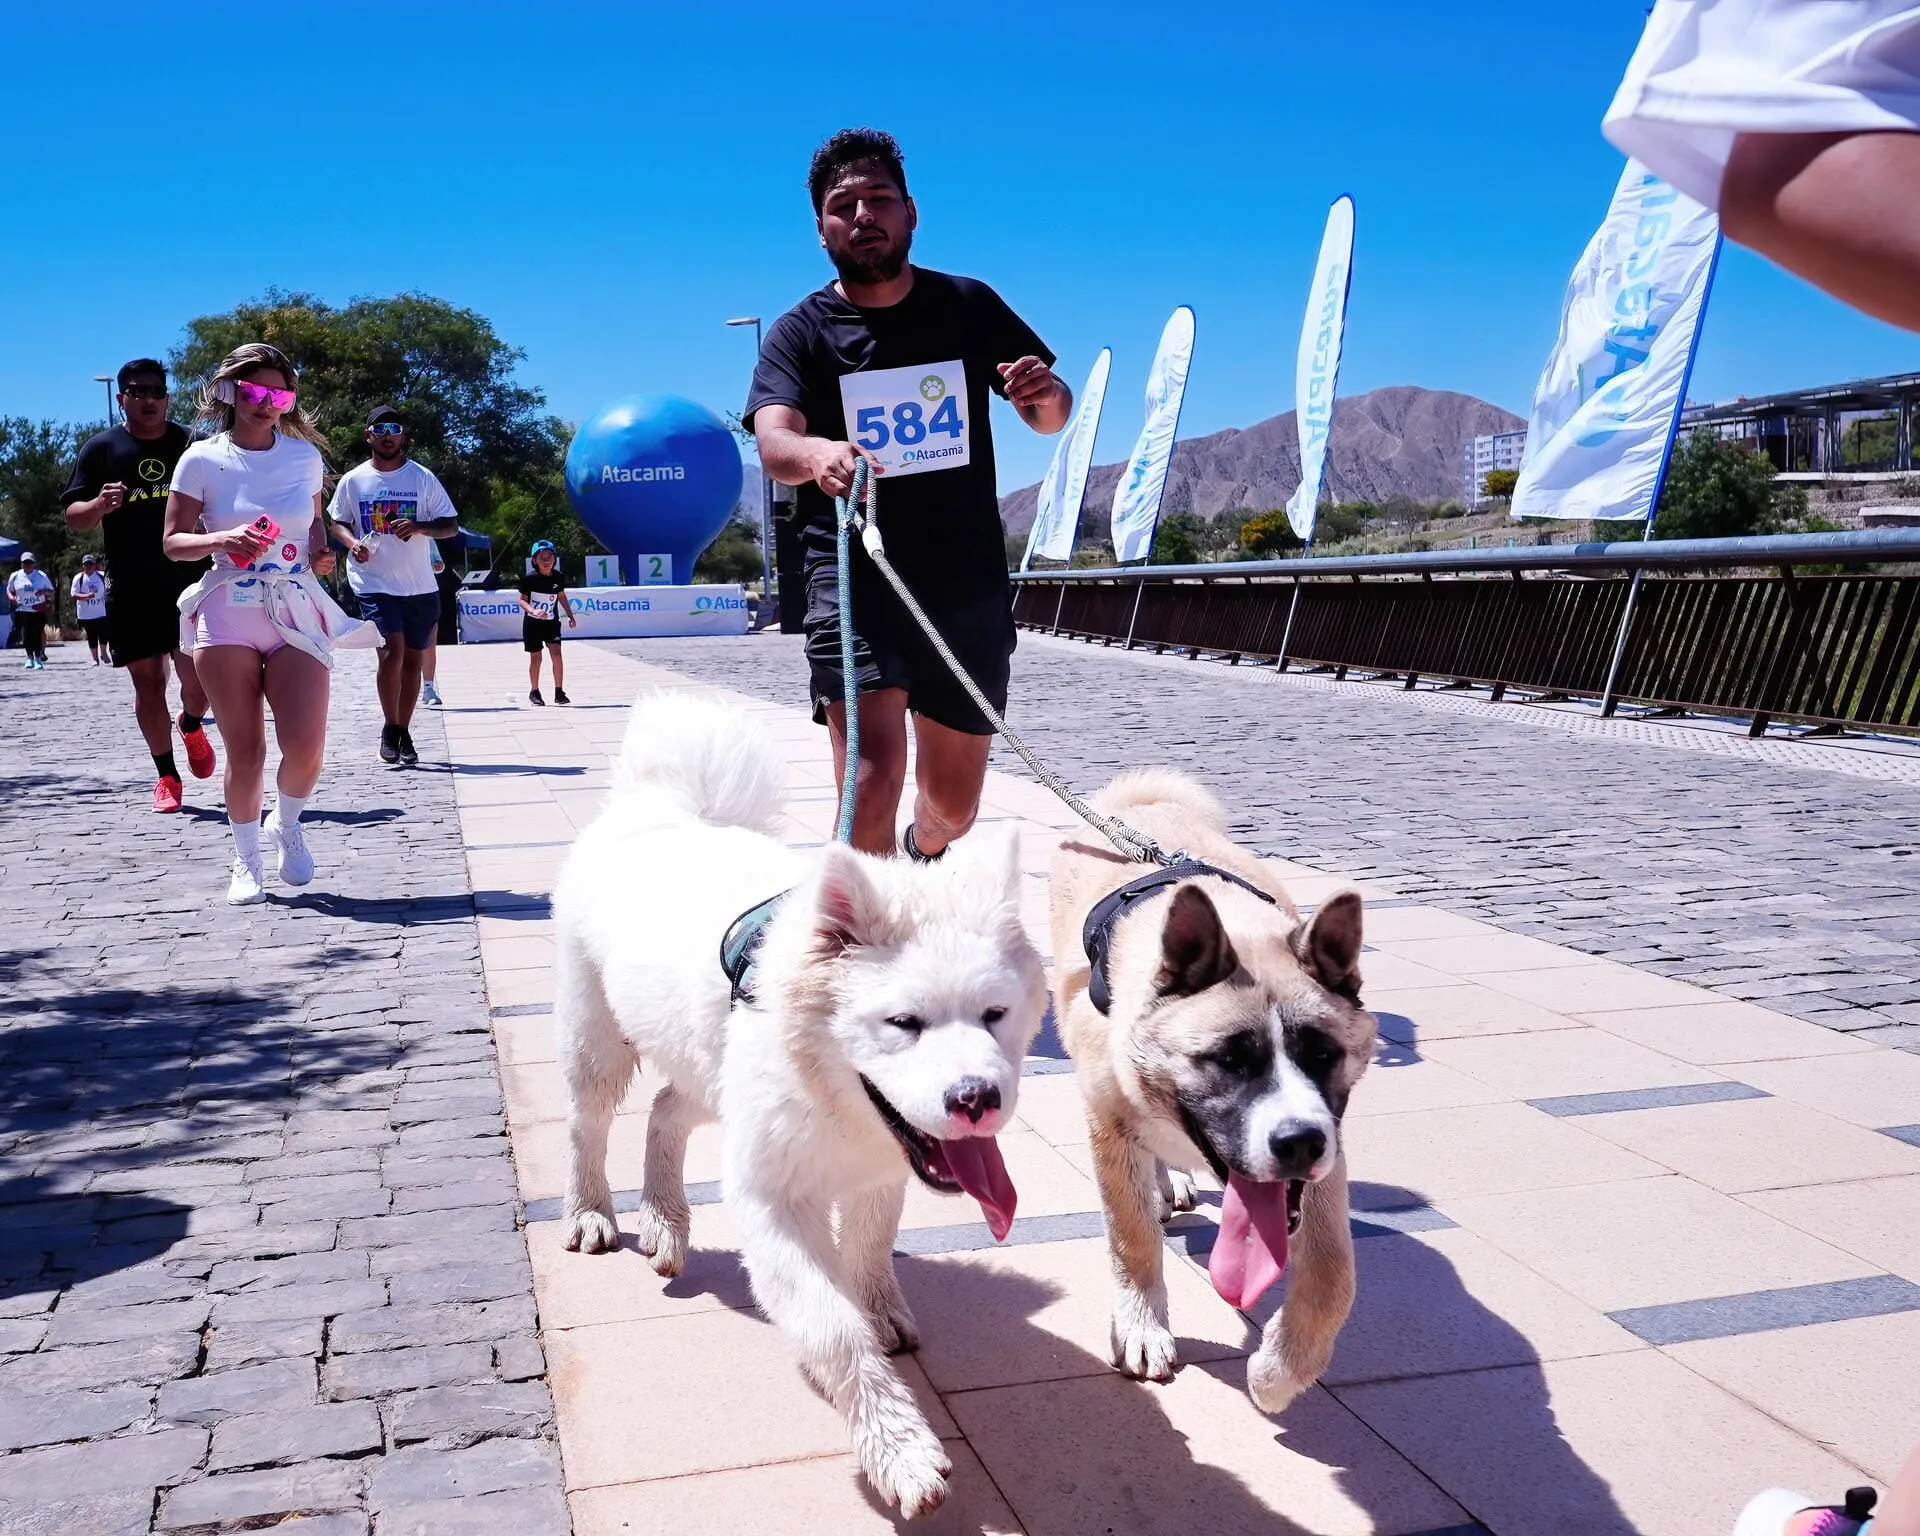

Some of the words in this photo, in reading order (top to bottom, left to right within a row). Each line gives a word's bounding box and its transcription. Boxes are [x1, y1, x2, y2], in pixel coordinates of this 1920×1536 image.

[857, 396, 964, 451] 584
[917, 446, 964, 461] Atacama
[601, 465, 685, 484] Atacama
[387, 490, 418, 498] Atacama
[284, 548, 295, 559] 5K
[598, 558, 607, 579] 1
[649, 556, 663, 577] 2
[585, 598, 650, 611] Atacama
